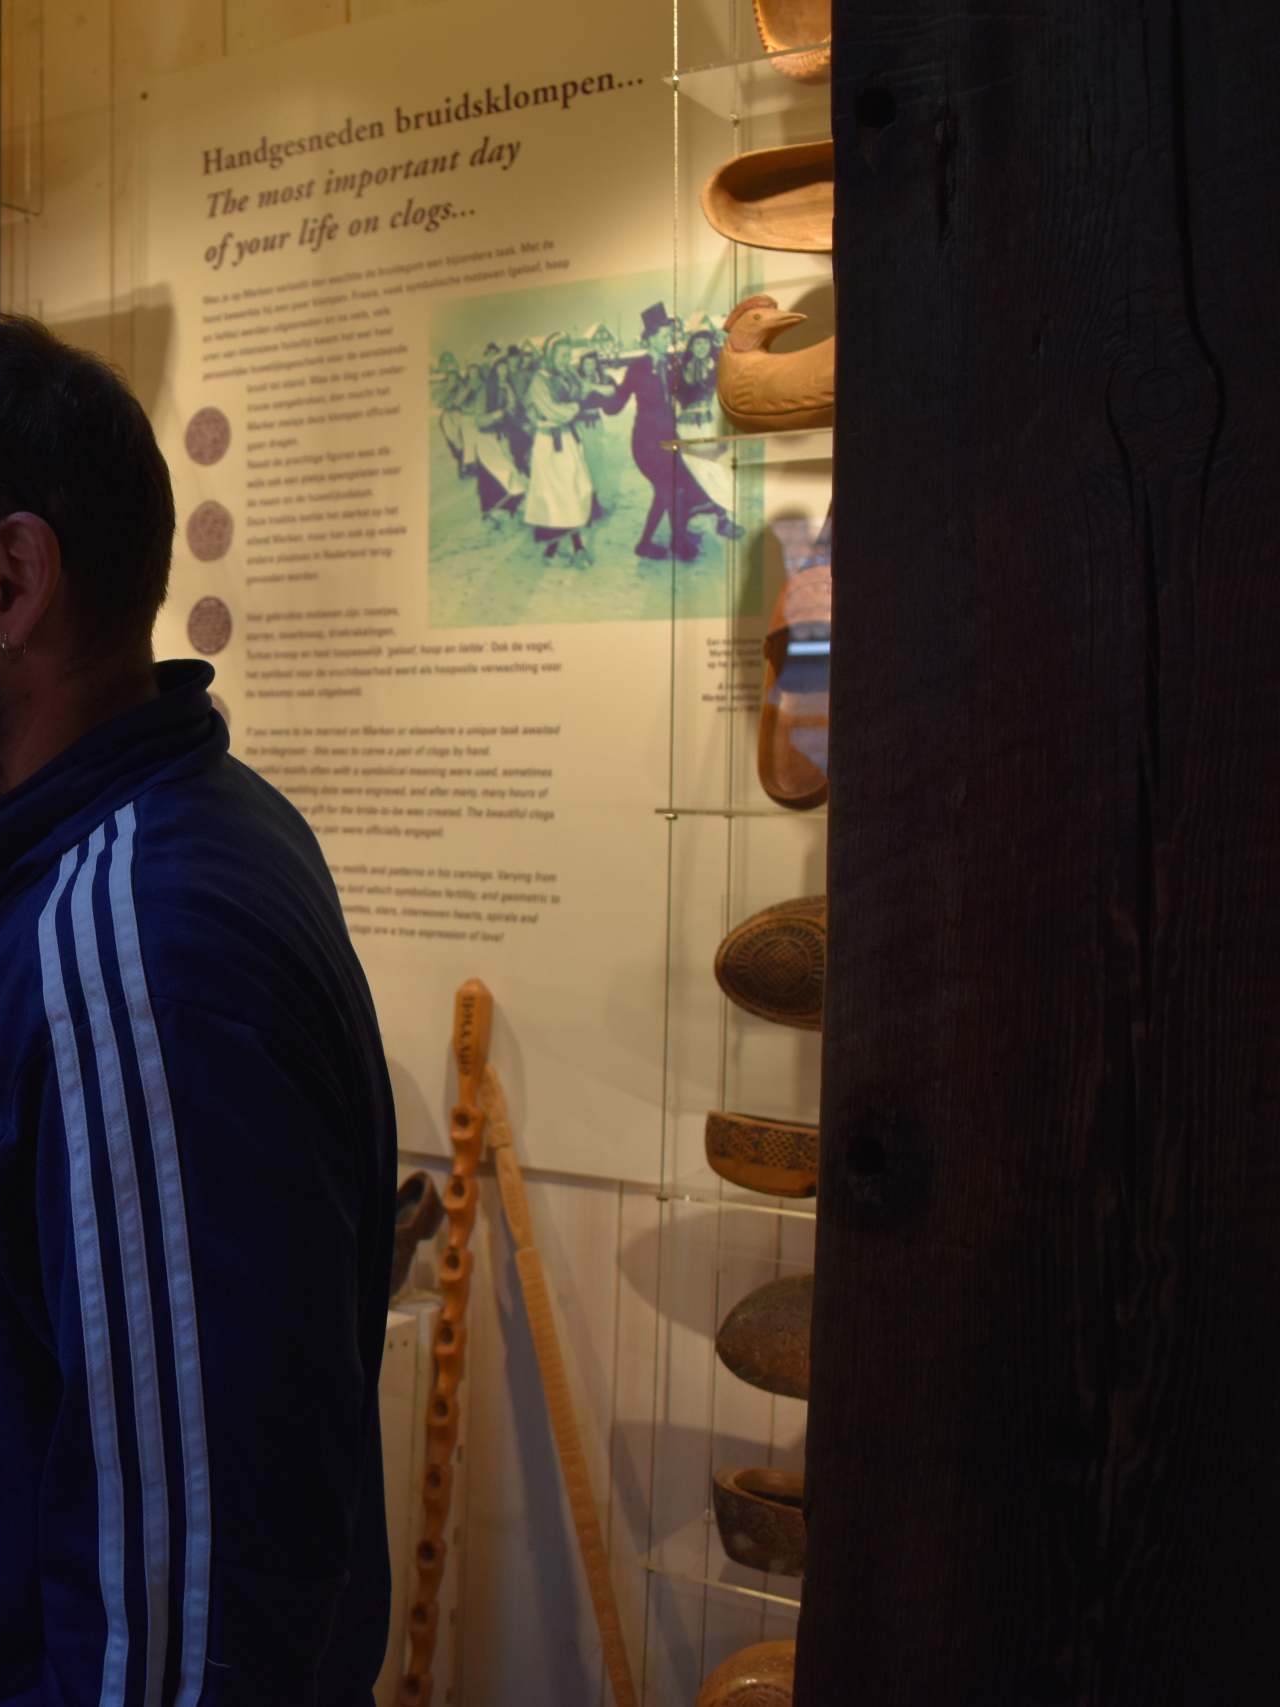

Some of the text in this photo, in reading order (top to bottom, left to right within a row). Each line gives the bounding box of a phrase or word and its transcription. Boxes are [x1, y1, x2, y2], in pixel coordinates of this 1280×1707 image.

[202, 71, 644, 176] Handgesneden bruidsklompen...
[206, 135, 522, 218] The most important day
[204, 197, 475, 270] of your life on clogs...
